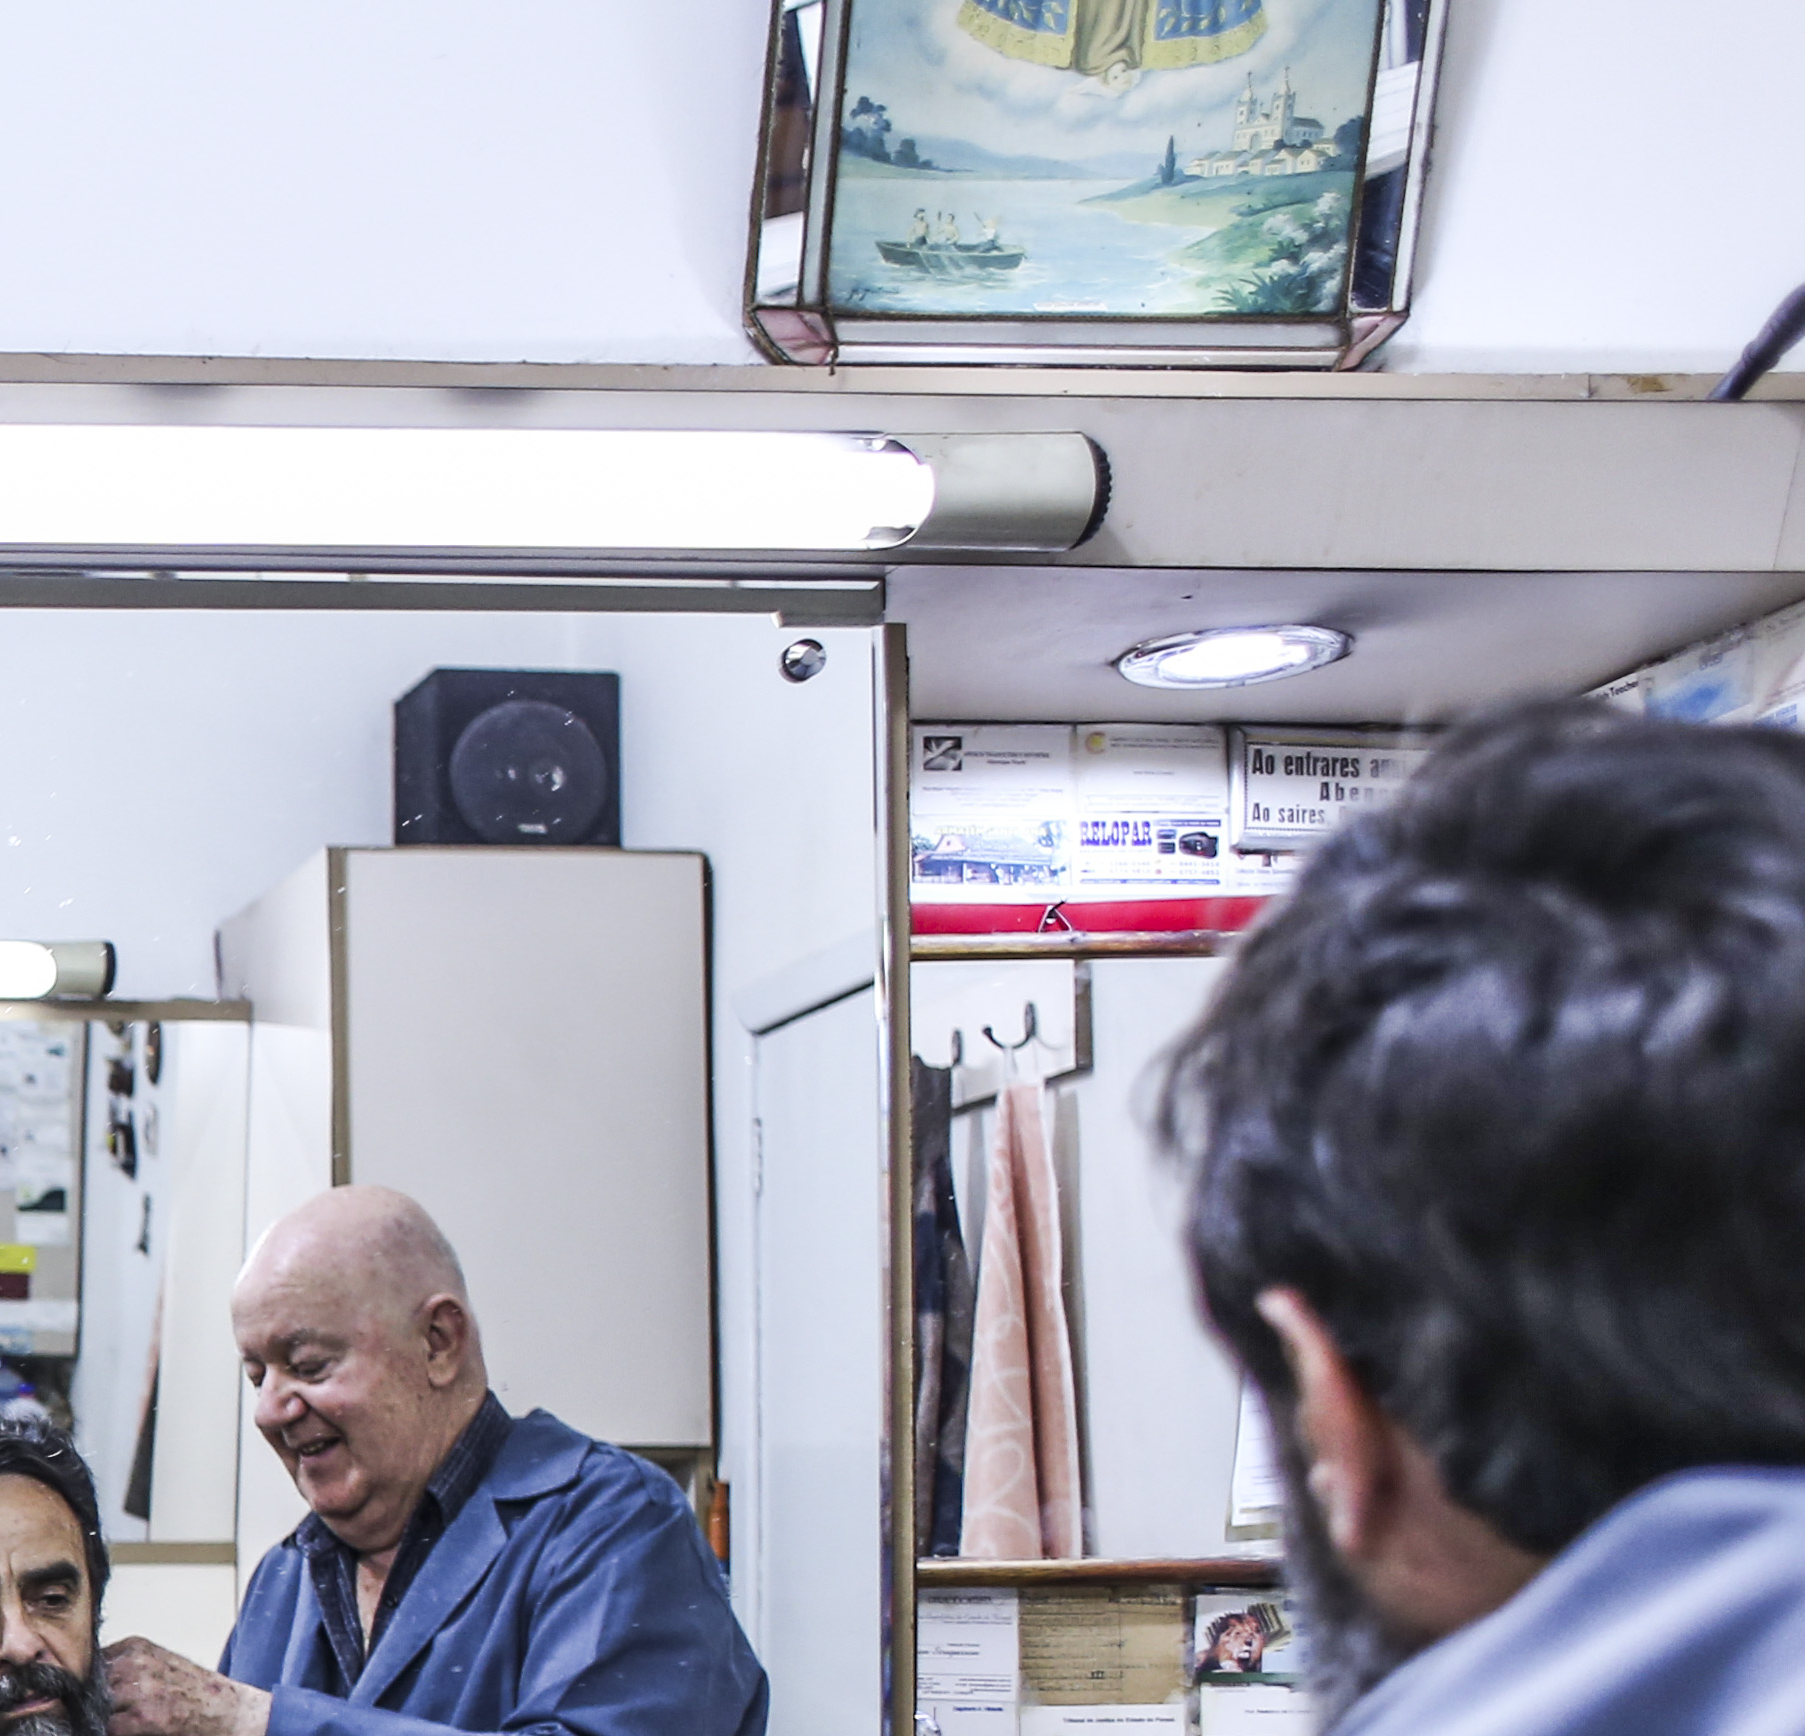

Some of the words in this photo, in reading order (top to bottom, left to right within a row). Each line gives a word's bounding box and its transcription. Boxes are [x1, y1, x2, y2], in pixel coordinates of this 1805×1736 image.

[1252, 750, 1274, 776] Ao
[1283, 751, 1359, 778] entrares
[1252, 803, 1270, 823] Ao
[1079, 821, 1152, 846] RELOPAR
